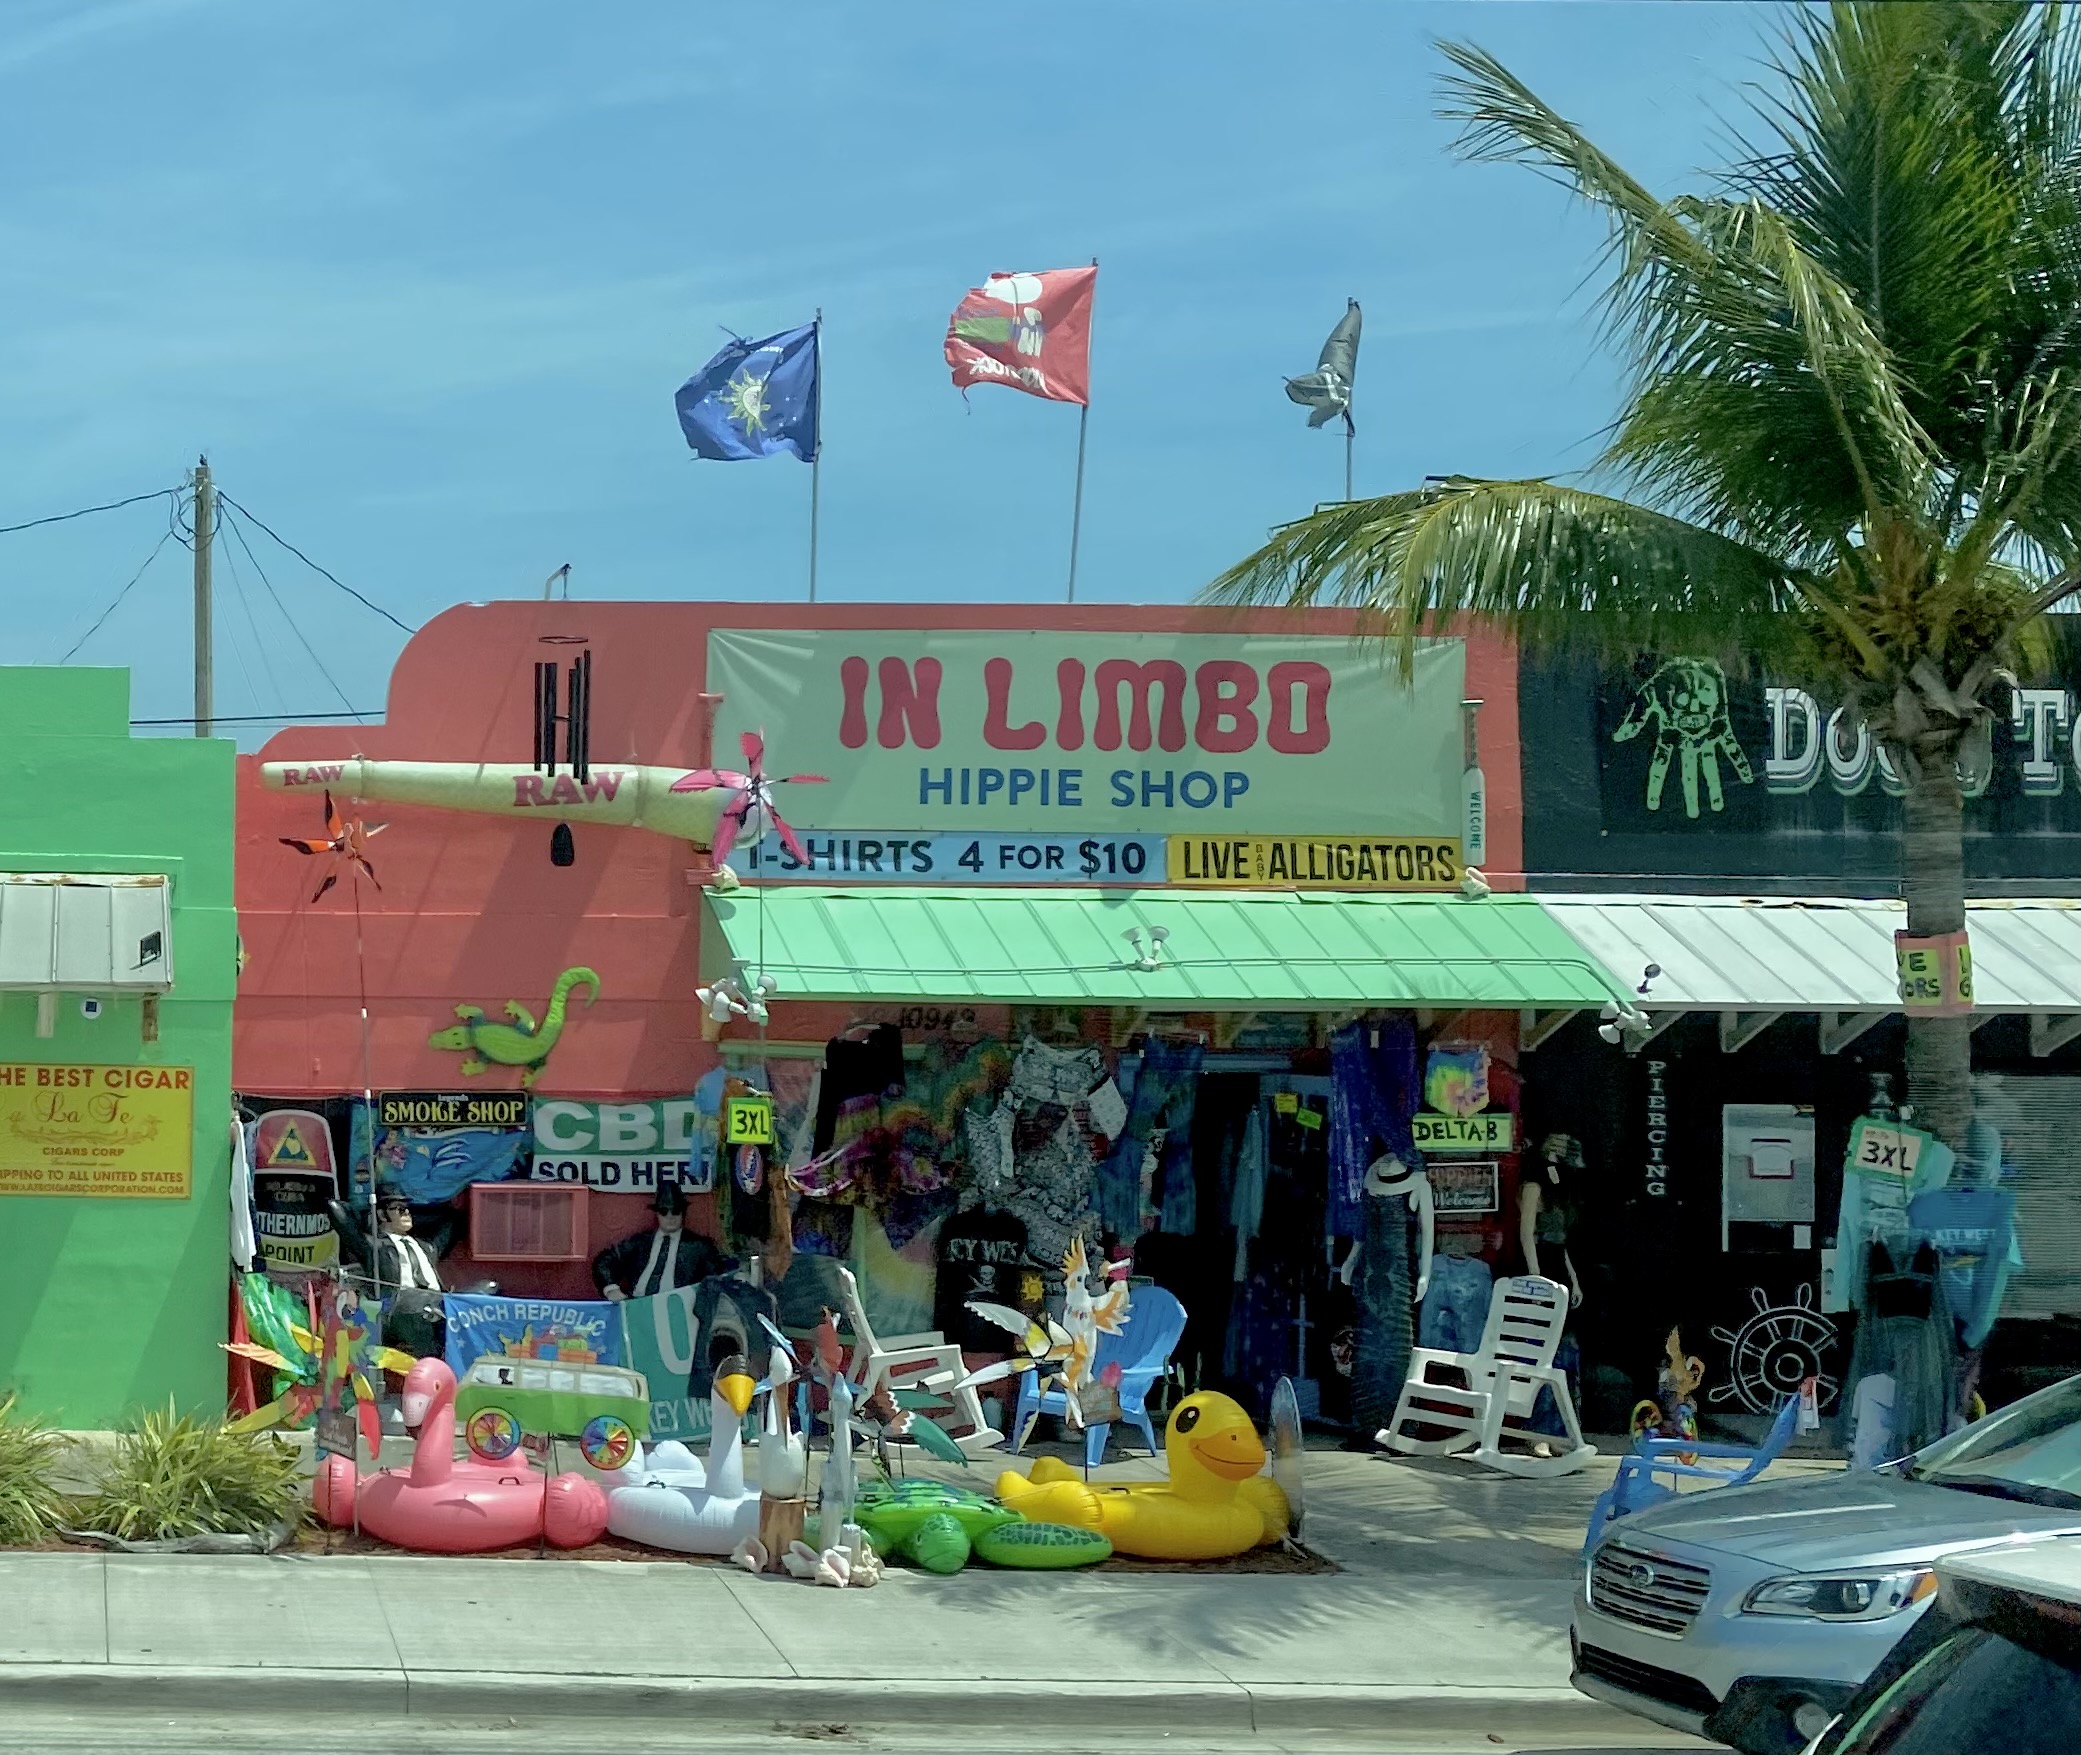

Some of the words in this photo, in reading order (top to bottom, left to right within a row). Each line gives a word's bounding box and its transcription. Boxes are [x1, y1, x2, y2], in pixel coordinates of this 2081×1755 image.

[839, 655, 943, 750] IN
[983, 656, 1332, 754] LIMBO
[284, 764, 345, 786] RAW
[513, 771, 625, 807] RAW
[919, 767, 1084, 806] HIPPIE
[1110, 769, 1250, 808] SHOP
[1470, 791, 1482, 849] WELCOME
[958, 841, 985, 873] 4
[999, 845, 1064, 870] FOR
[1080, 838, 1146, 879] $10
[1184, 841, 1250, 879] LIVE
[1268, 842, 1456, 882] ALLIGATORS
[37, 1068, 95, 1087] BEST
[104, 1069, 190, 1090] CIGAR
[384, 1100, 462, 1123] SMOKE
[467, 1100, 524, 1122] SHOP
[533, 1101, 697, 1150] CBD
[735, 1110, 768, 1135] 3XL
[1645, 1061, 1669, 1196] PIERCING
[42, 1147, 88, 1156] CIGARS
[91, 1148, 125, 1156] CORP
[1862, 1141, 1912, 1171] 3XL
[48, 1170, 64, 1180] TO
[68, 1170, 91, 1181] ALL
[93, 1171, 137, 1182] UNITED
[141, 1172, 183, 1183] STATES
[538, 1161, 621, 1185] SOLD
[266, 1244, 315, 1264] POINT
[447, 1304, 508, 1334] CONCH
[514, 1303, 607, 1337] REPUBLIC
